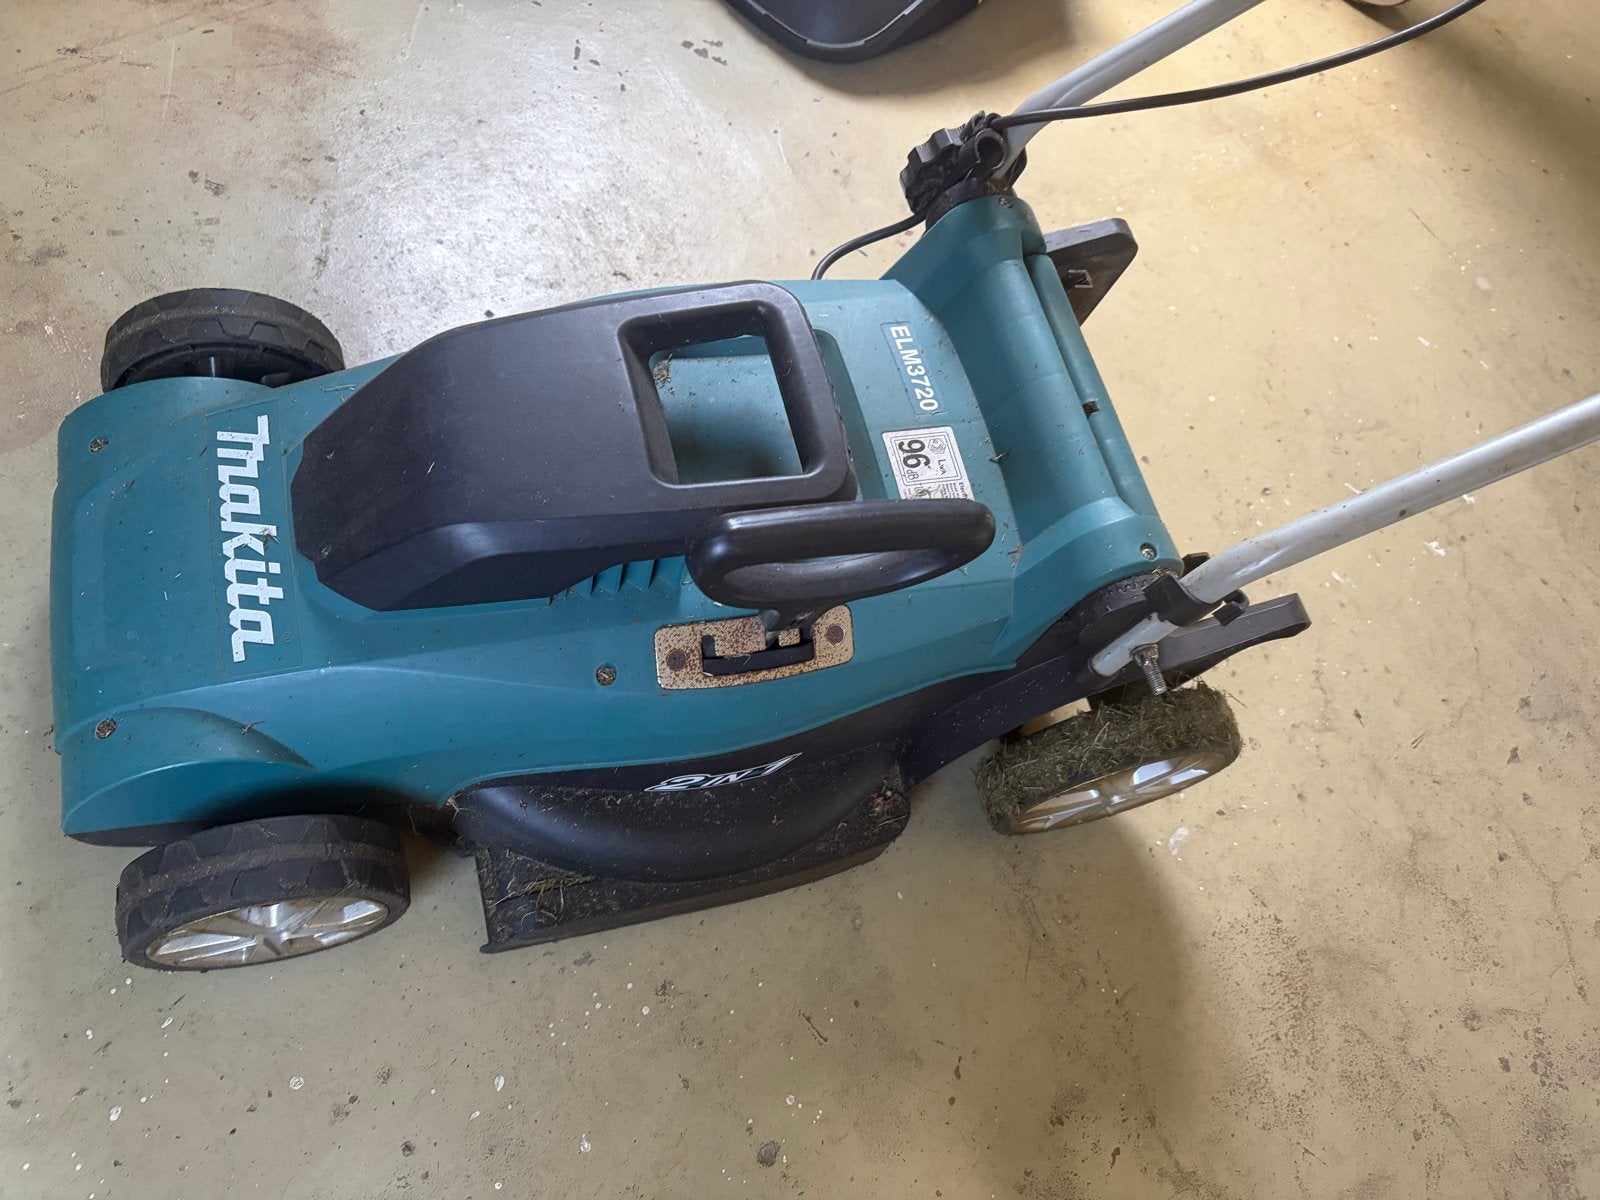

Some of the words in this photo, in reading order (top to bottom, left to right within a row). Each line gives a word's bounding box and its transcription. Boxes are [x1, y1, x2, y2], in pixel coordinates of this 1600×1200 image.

[890, 325, 939, 411] ELM3720
[898, 439, 930, 468] 96
[906, 469, 919, 480] dB
